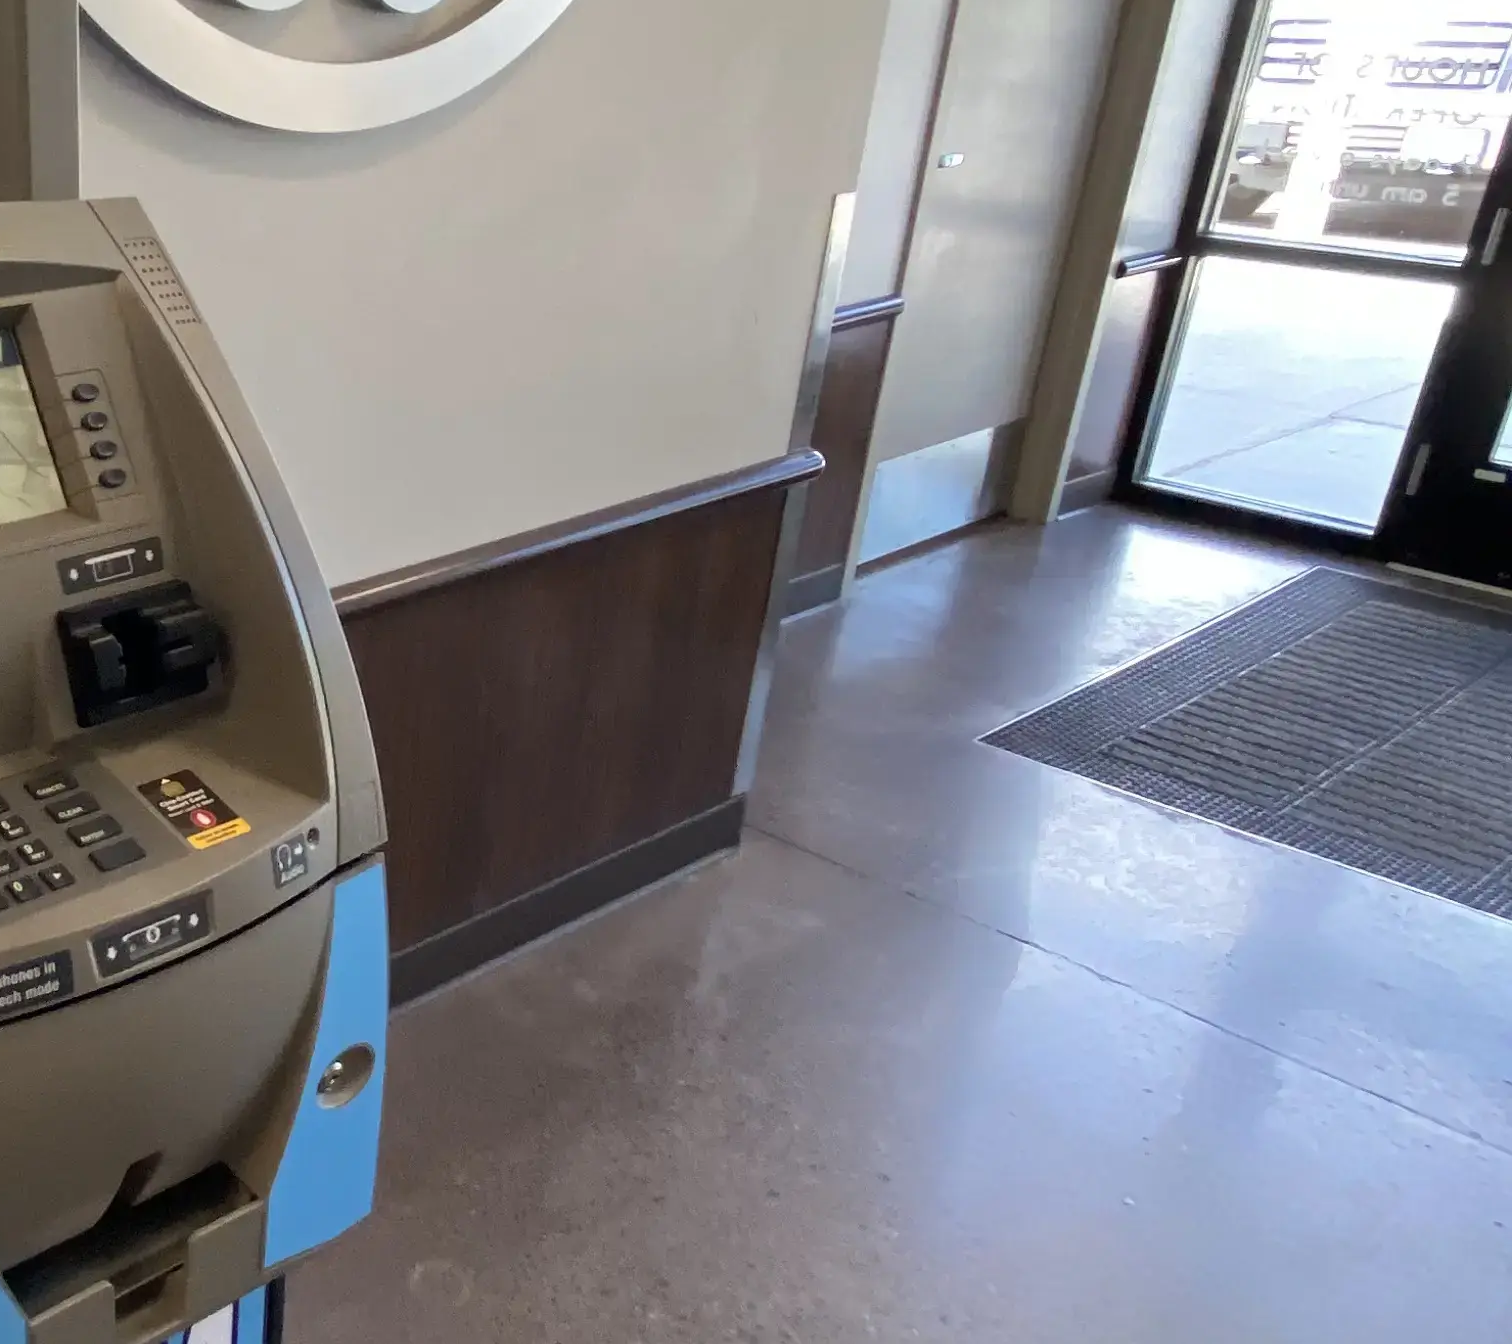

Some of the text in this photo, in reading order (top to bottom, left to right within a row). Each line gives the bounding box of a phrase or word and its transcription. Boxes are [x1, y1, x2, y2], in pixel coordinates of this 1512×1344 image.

[12, 881, 23, 892] 0
[43, 960, 56, 975] in
[25, 978, 61, 1000] mode
